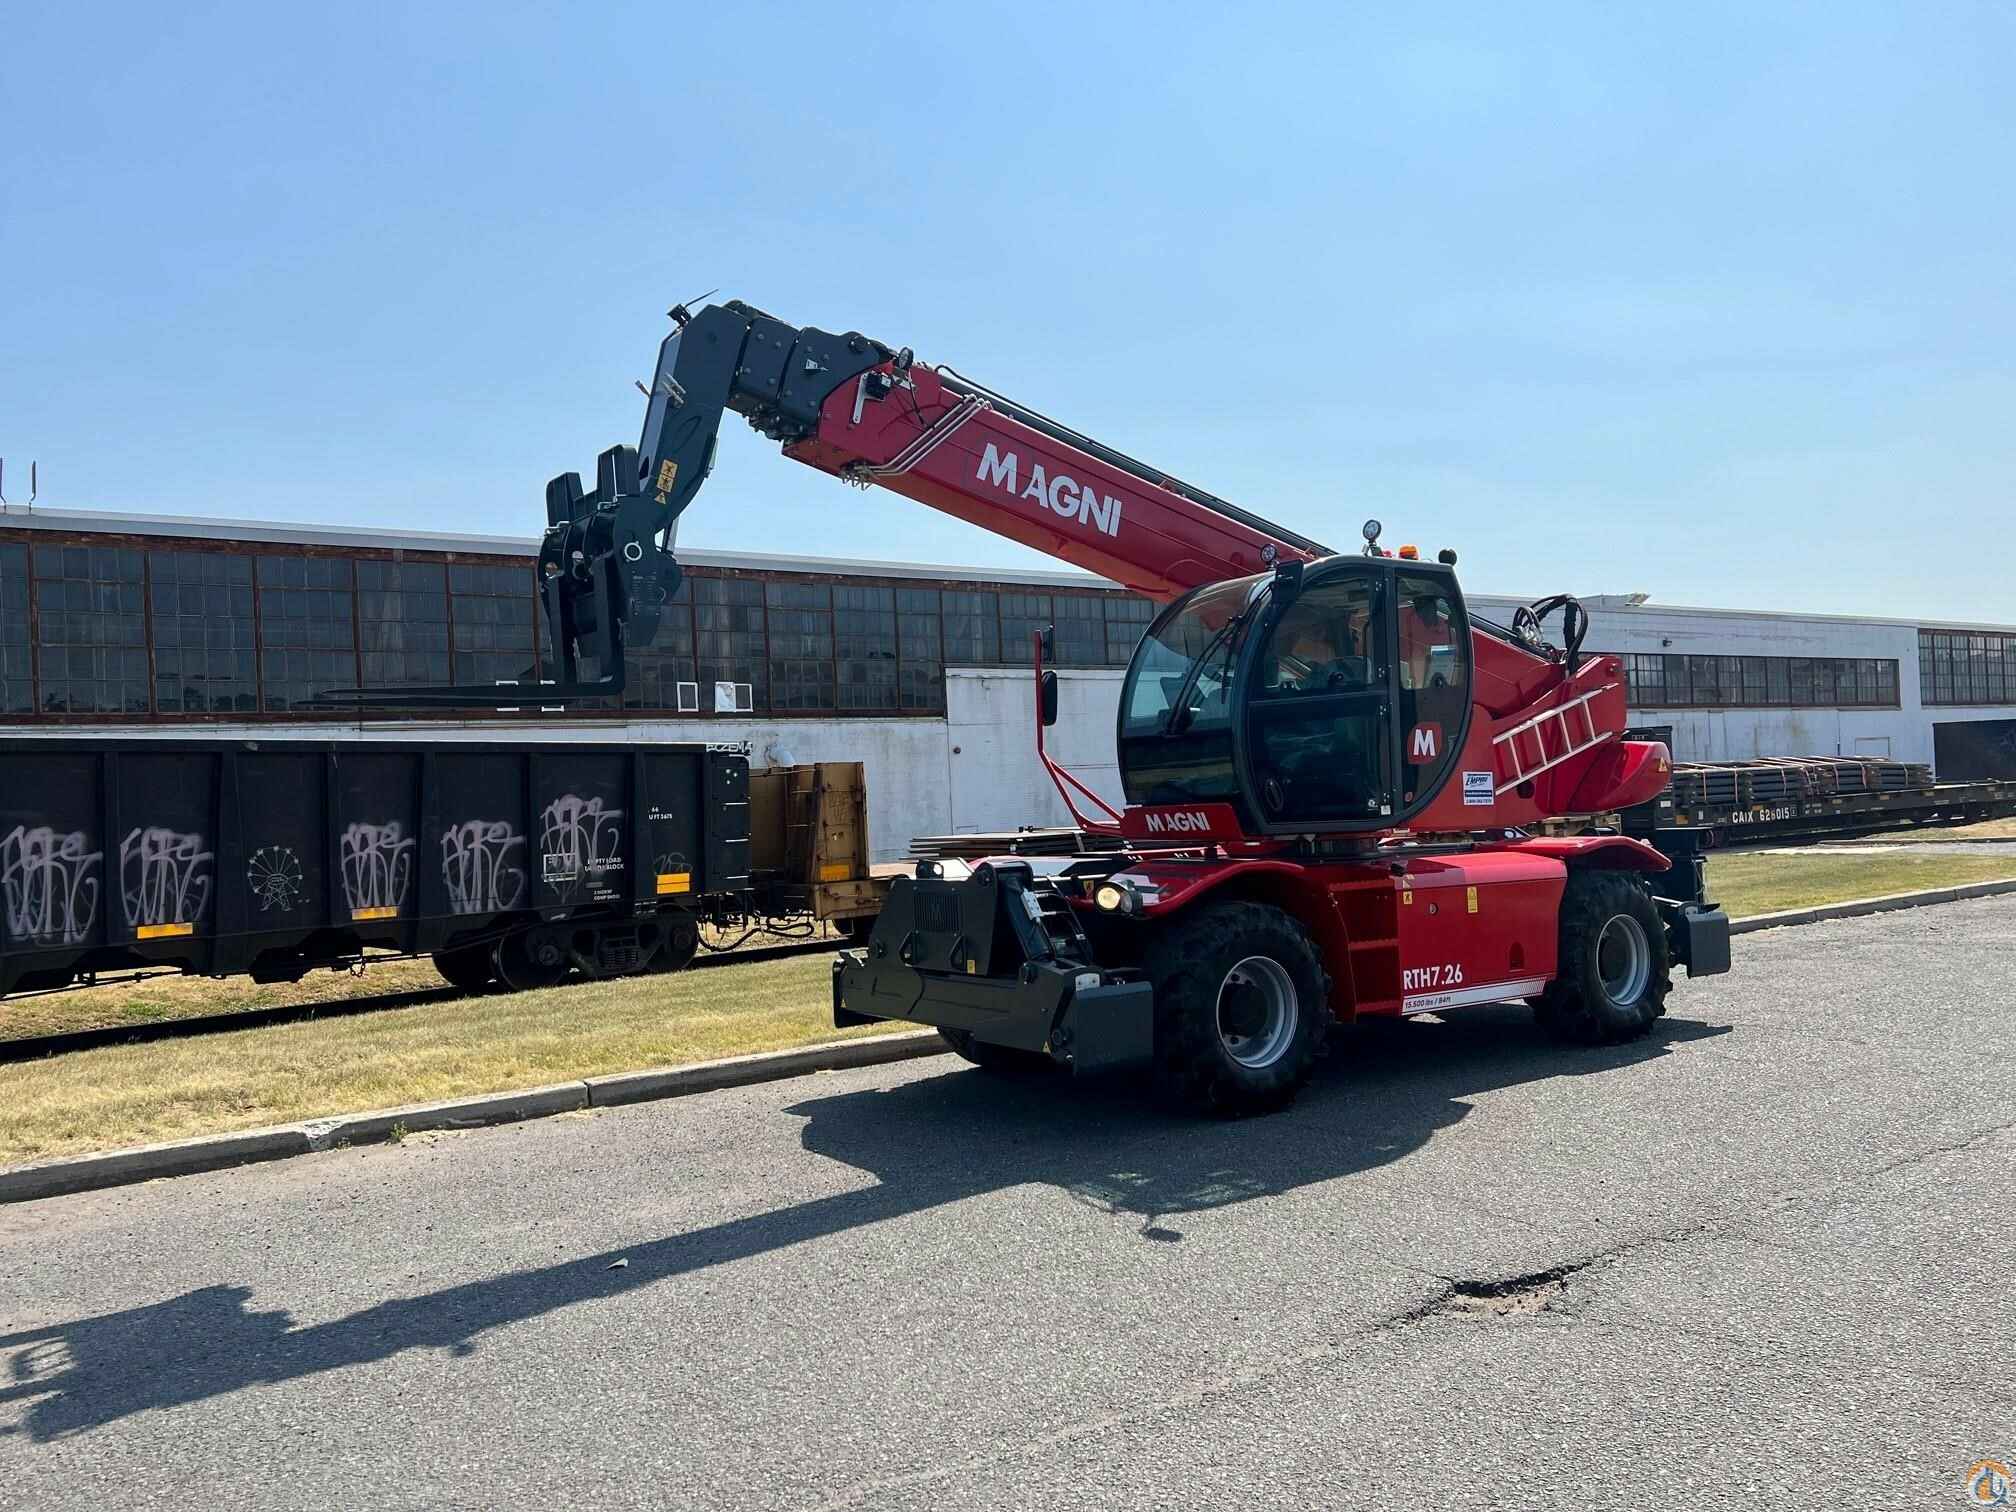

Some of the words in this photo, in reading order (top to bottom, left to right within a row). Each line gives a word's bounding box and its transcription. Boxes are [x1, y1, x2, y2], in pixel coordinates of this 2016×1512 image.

[976, 442, 1122, 537] MAGNI
[1413, 728, 1436, 756] M
[1145, 811, 1211, 832] MAGNI
[1732, 810, 1754, 823] CAIX
[1403, 963, 1463, 990] RTH7.26
